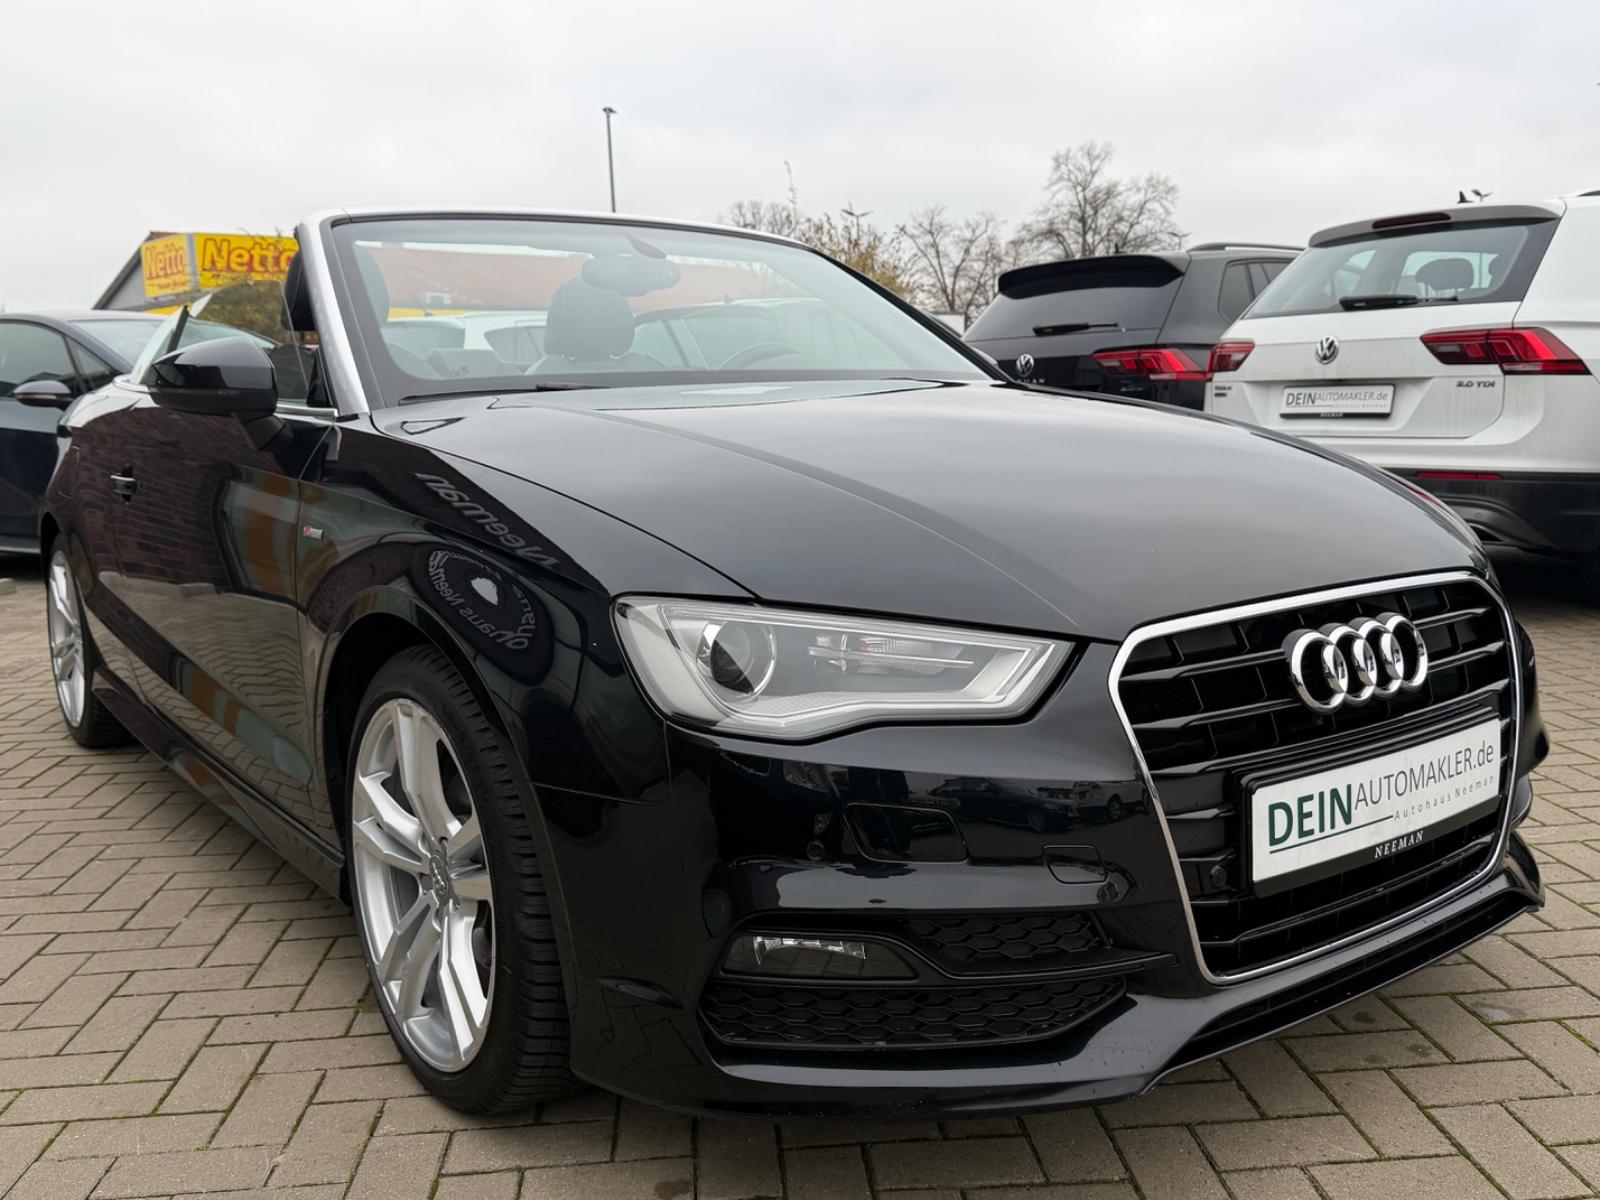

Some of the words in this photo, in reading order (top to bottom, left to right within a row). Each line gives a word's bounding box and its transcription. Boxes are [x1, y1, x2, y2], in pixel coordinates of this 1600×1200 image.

[146, 243, 185, 280] Netto
[1394, 793, 1452, 821] Autohaus
[1455, 777, 1494, 799] Neeman
[1374, 830, 1424, 859] NEEMAN
